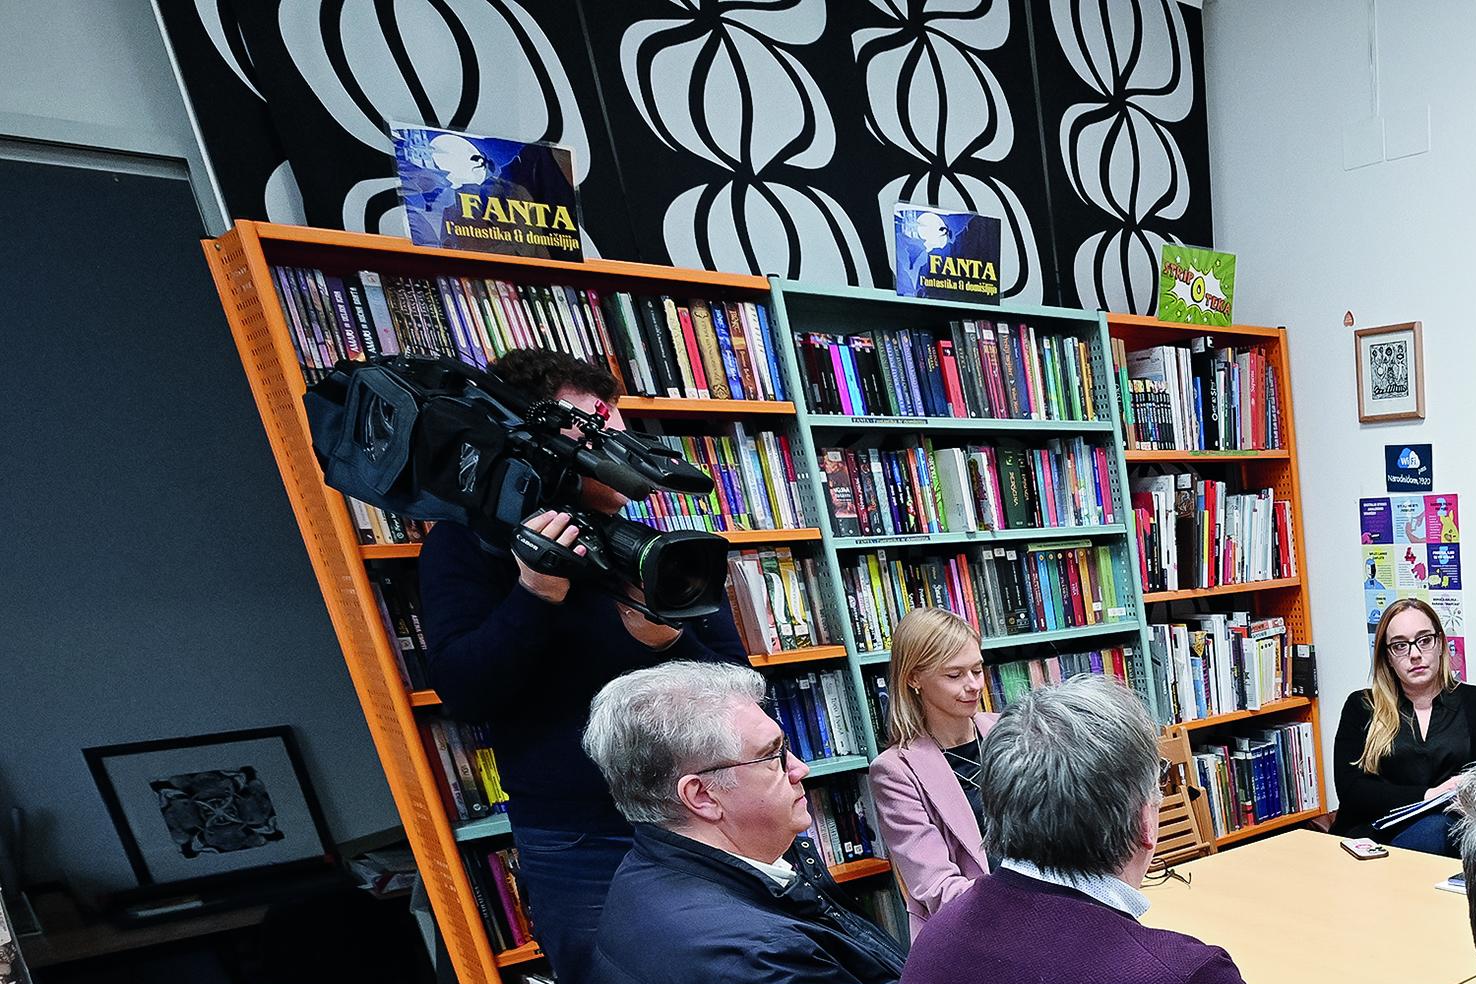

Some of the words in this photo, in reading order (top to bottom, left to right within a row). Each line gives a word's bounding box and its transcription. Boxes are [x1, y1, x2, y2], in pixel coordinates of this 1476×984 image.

[459, 193, 576, 231] FANTA
[446, 221, 511, 242] Fantastika
[526, 231, 579, 251] domišljija
[929, 255, 997, 281] FANTA
[1163, 262, 1194, 285] STRIP
[1205, 293, 1231, 315] TEKA
[517, 534, 538, 551] Canon
